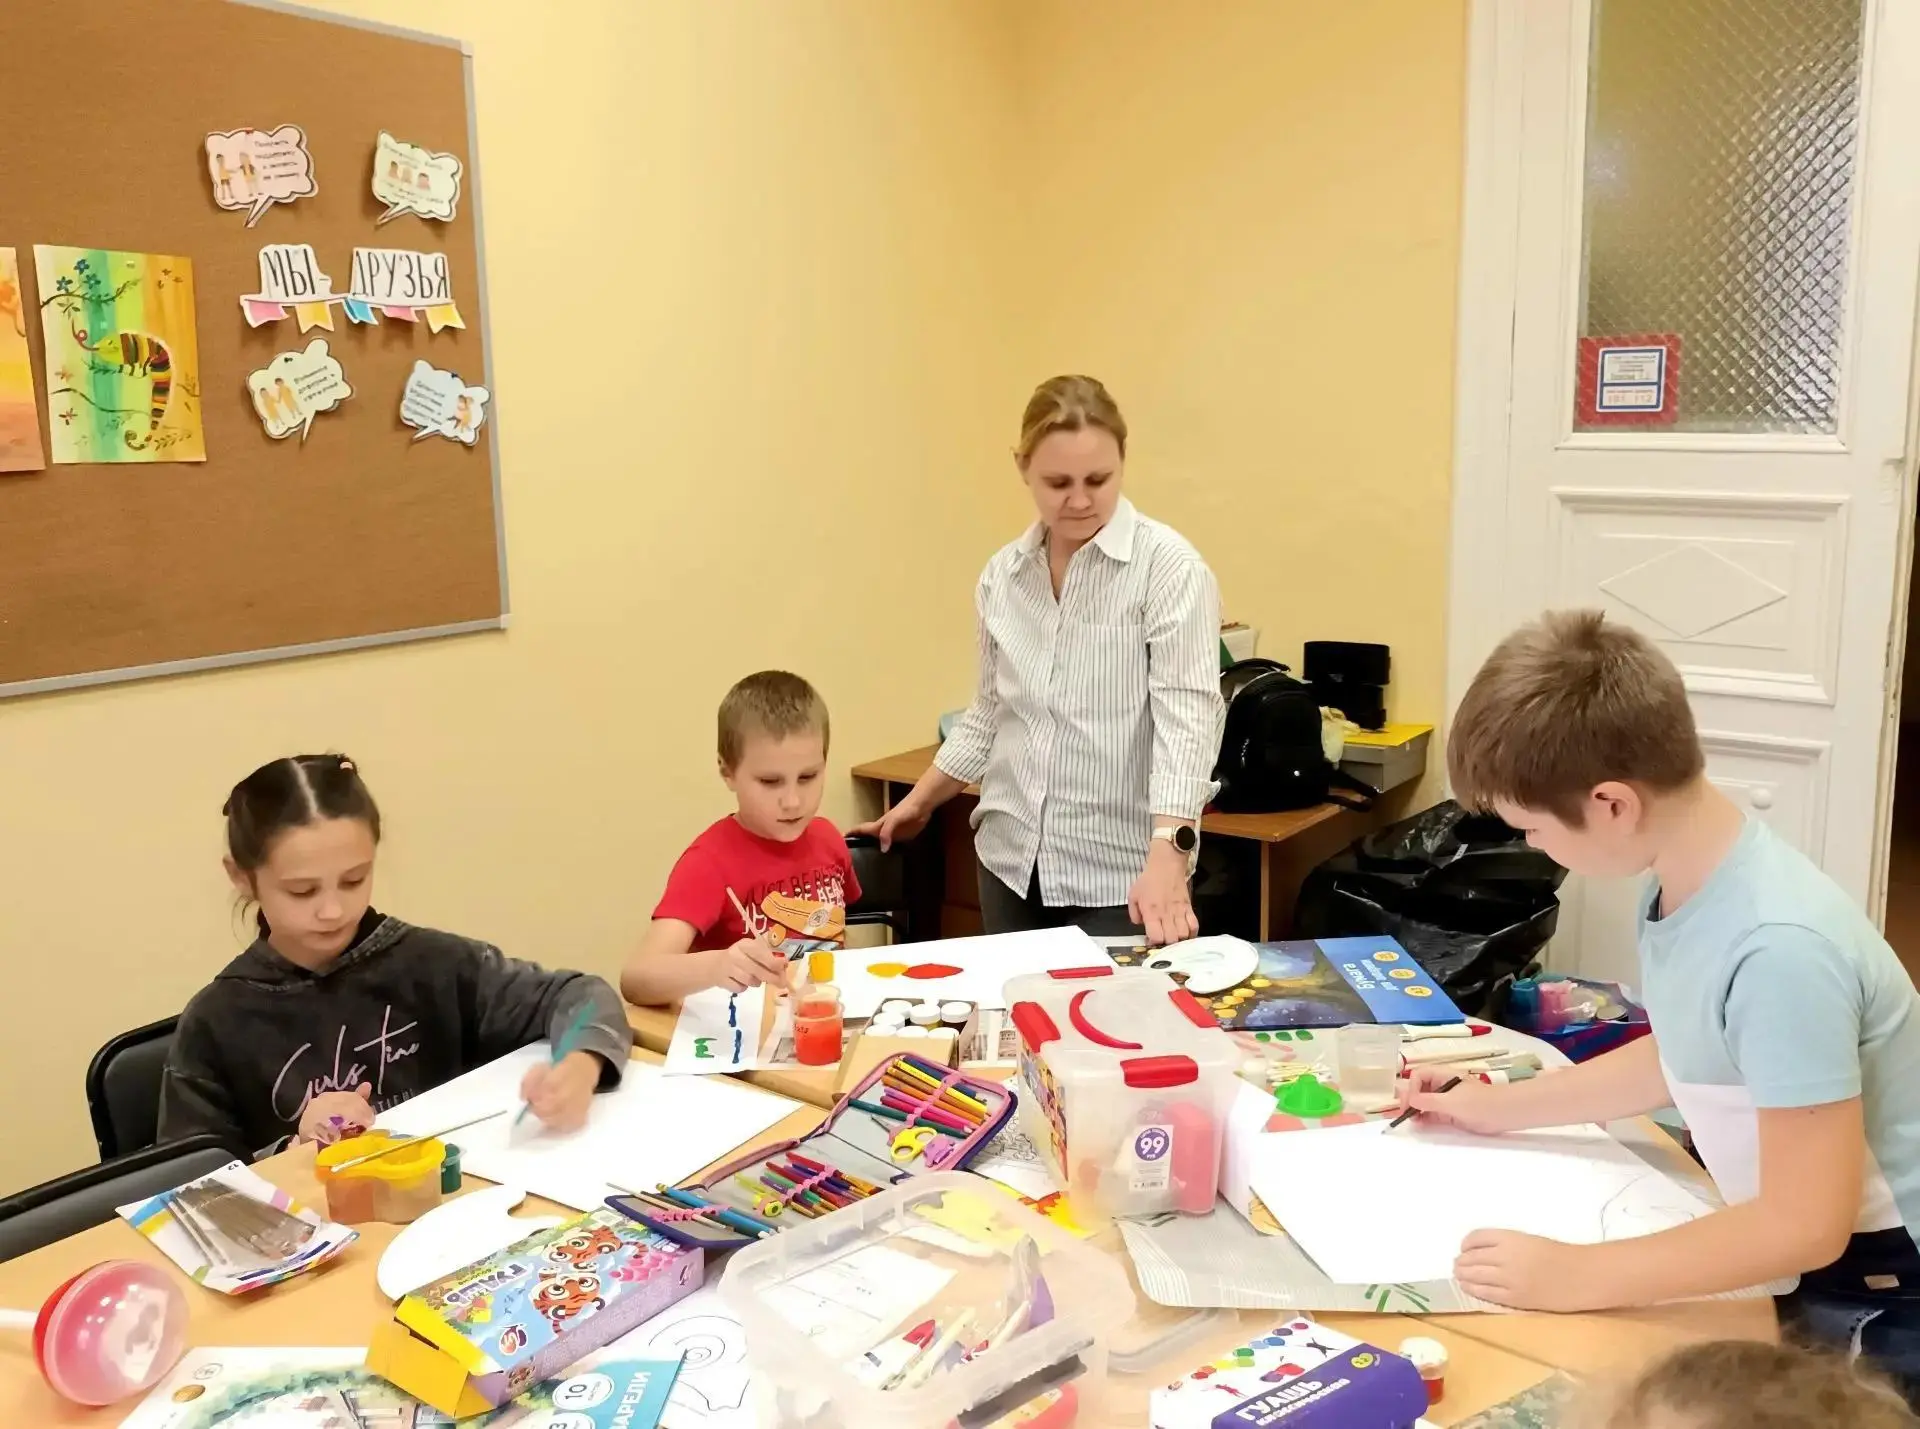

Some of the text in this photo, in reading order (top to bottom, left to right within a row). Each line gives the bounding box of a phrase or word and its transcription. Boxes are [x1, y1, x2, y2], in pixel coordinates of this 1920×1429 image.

[352, 250, 449, 299] ДРУЗЬЯ
[1140, 1136, 1165, 1155] 99
[446, 1263, 527, 1304] ГУАШЬ
[565, 1384, 588, 1401] 10
[1235, 1381, 1323, 1421] ГУАШЬ
